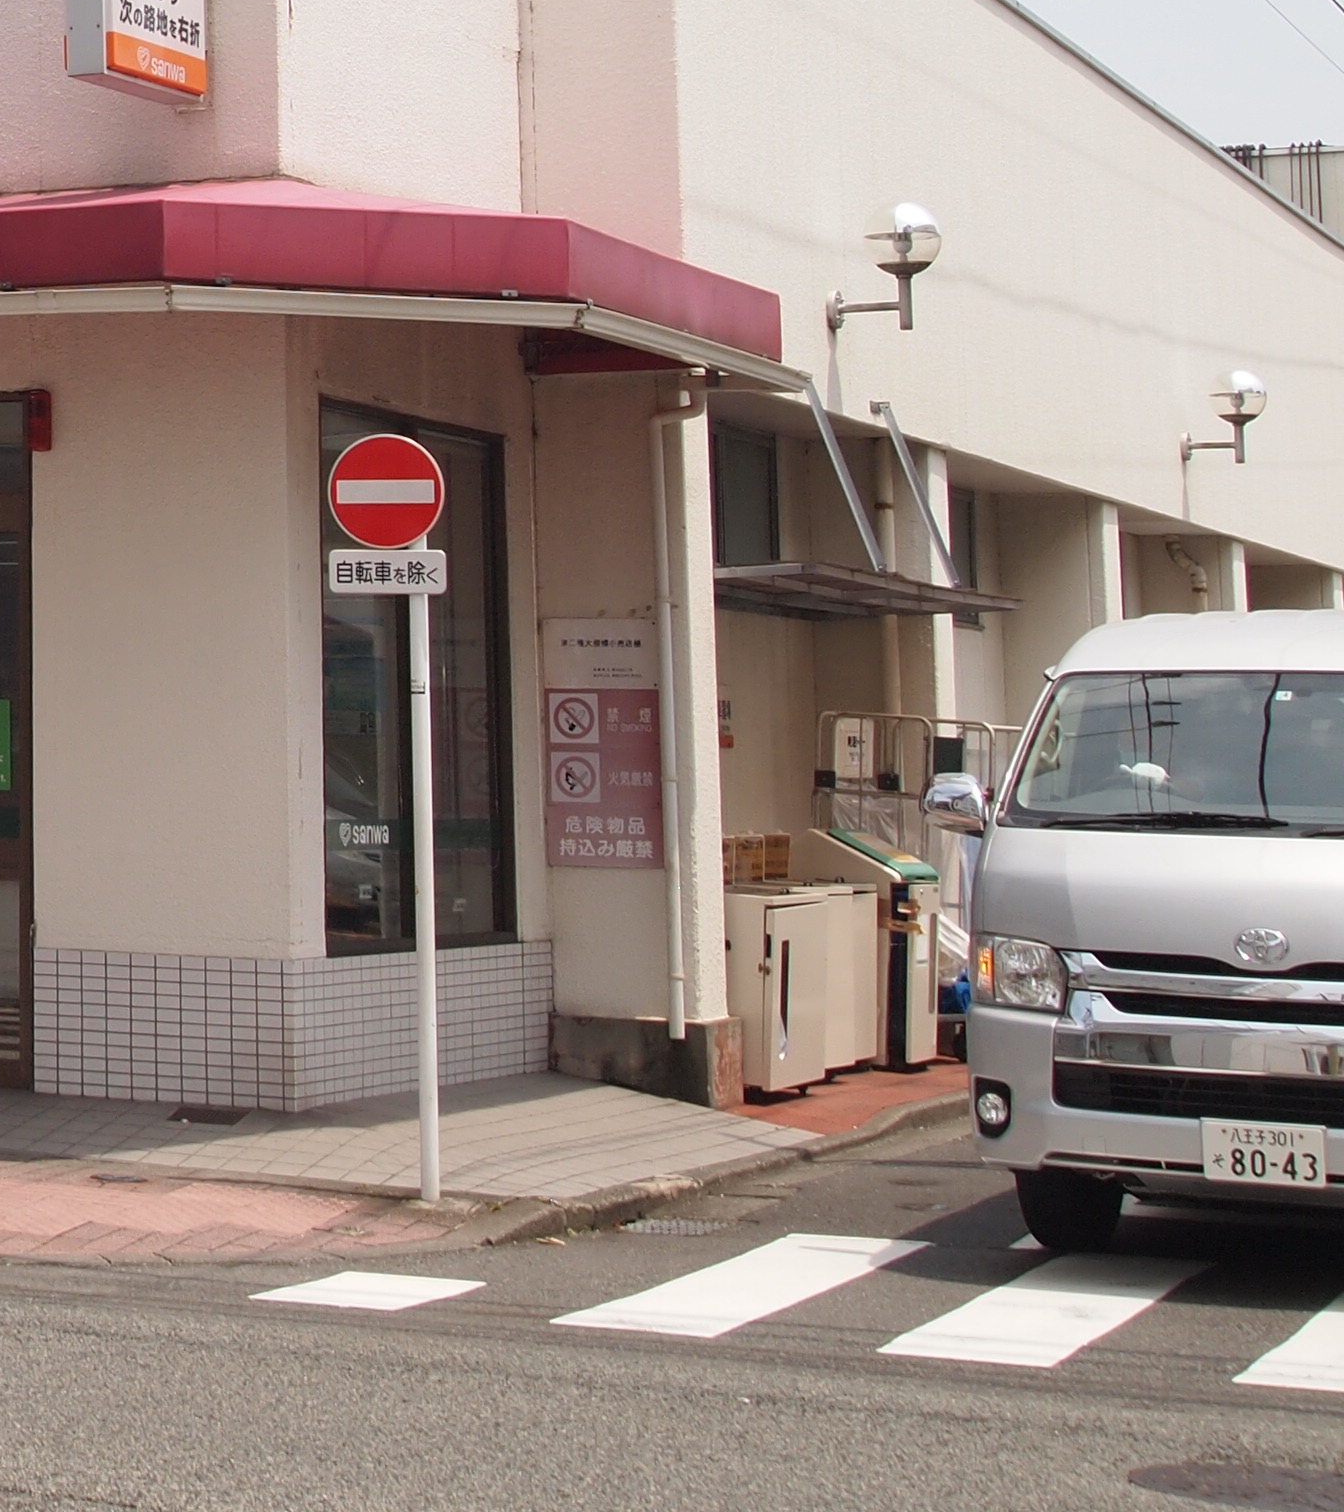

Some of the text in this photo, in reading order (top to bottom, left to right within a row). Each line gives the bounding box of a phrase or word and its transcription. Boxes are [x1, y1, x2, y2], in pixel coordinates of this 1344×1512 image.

[150, 58, 185, 83] sanwa
[336, 560, 440, 585] 自転車を除く
[352, 825, 390, 844] sanwa
[566, 815, 645, 835] 危険物品
[560, 838, 654, 858] 持込み厳禁
[1231, 1148, 1318, 1181] 80-43
